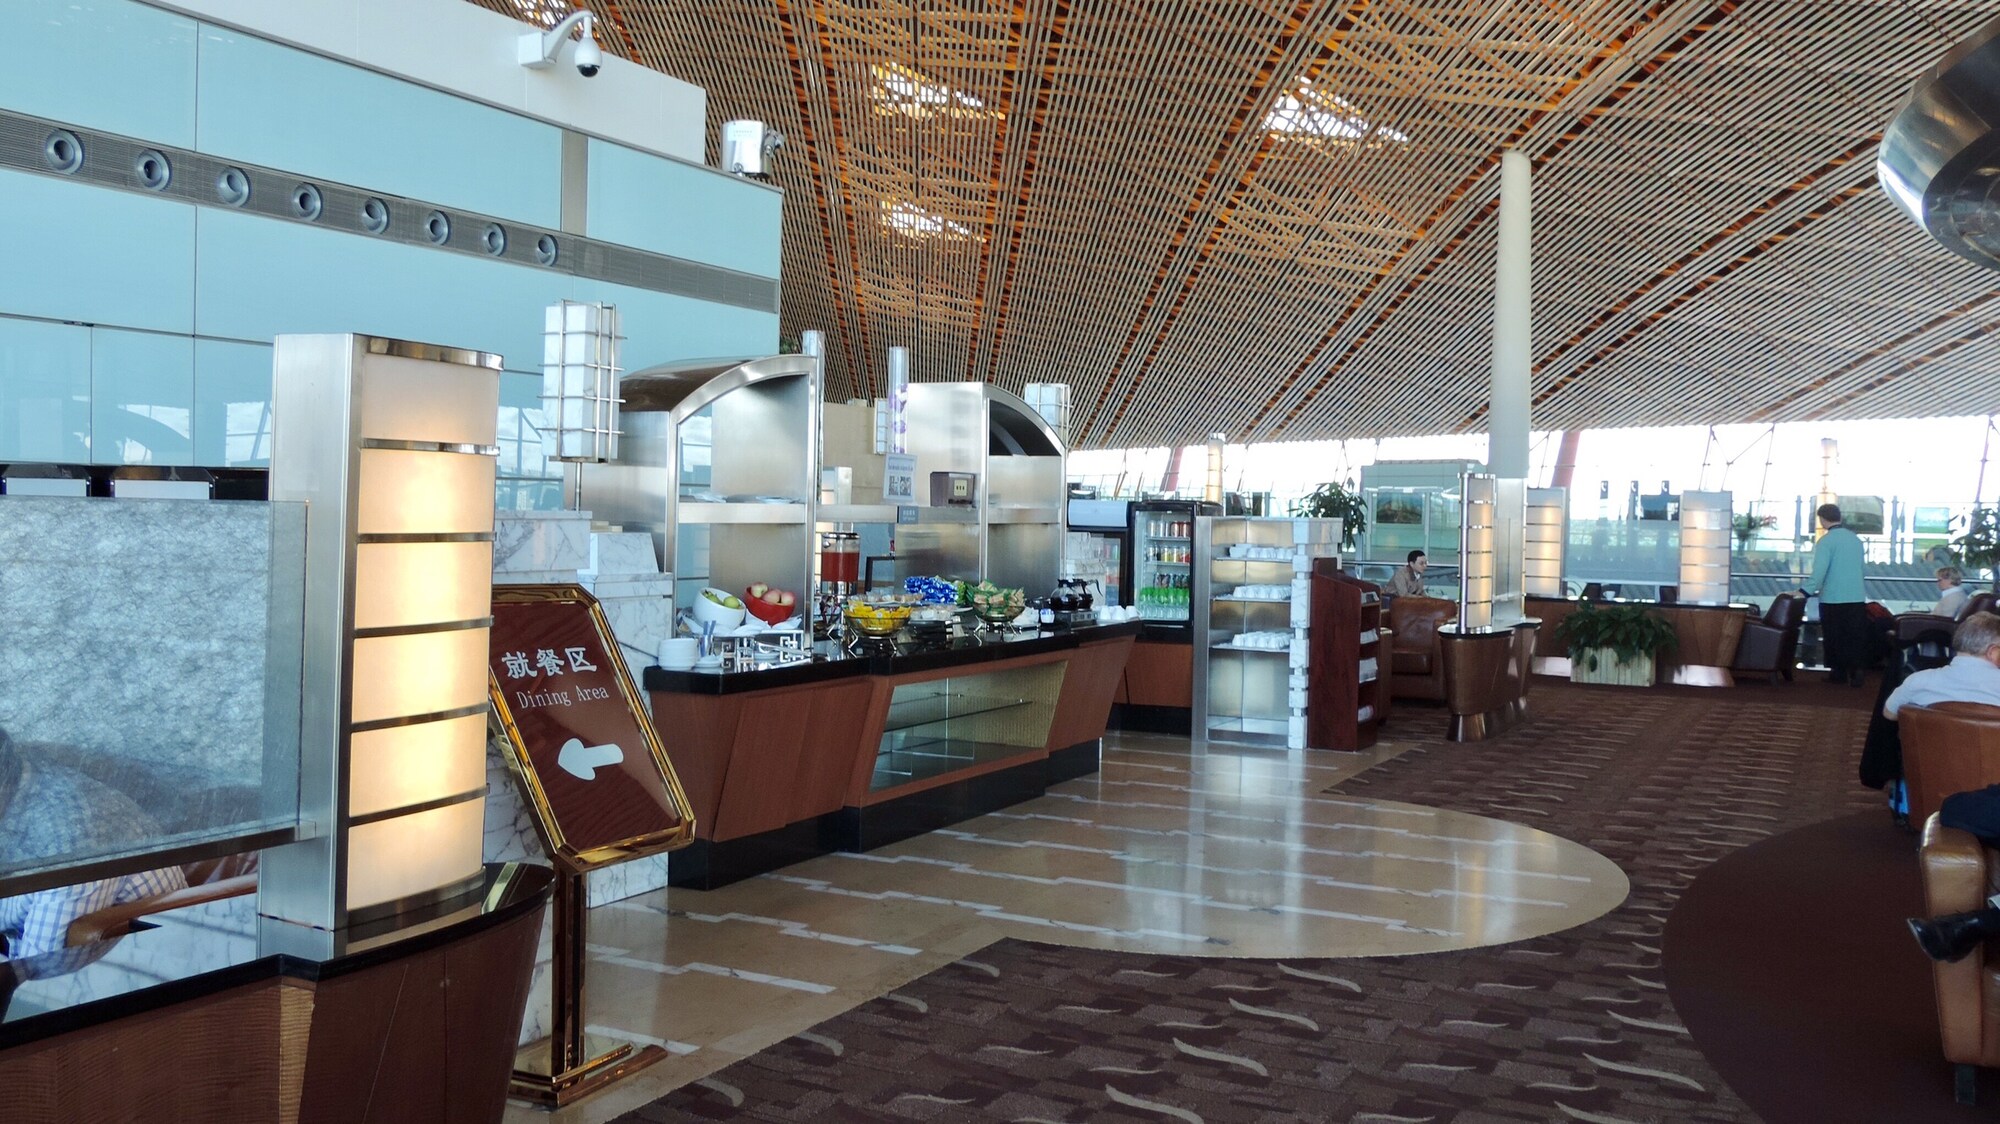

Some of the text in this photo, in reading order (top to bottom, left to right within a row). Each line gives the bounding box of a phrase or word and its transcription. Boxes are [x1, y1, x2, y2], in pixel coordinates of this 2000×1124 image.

[501, 647, 597, 679] 就餐区
[516, 685, 609, 709] Dining Area
